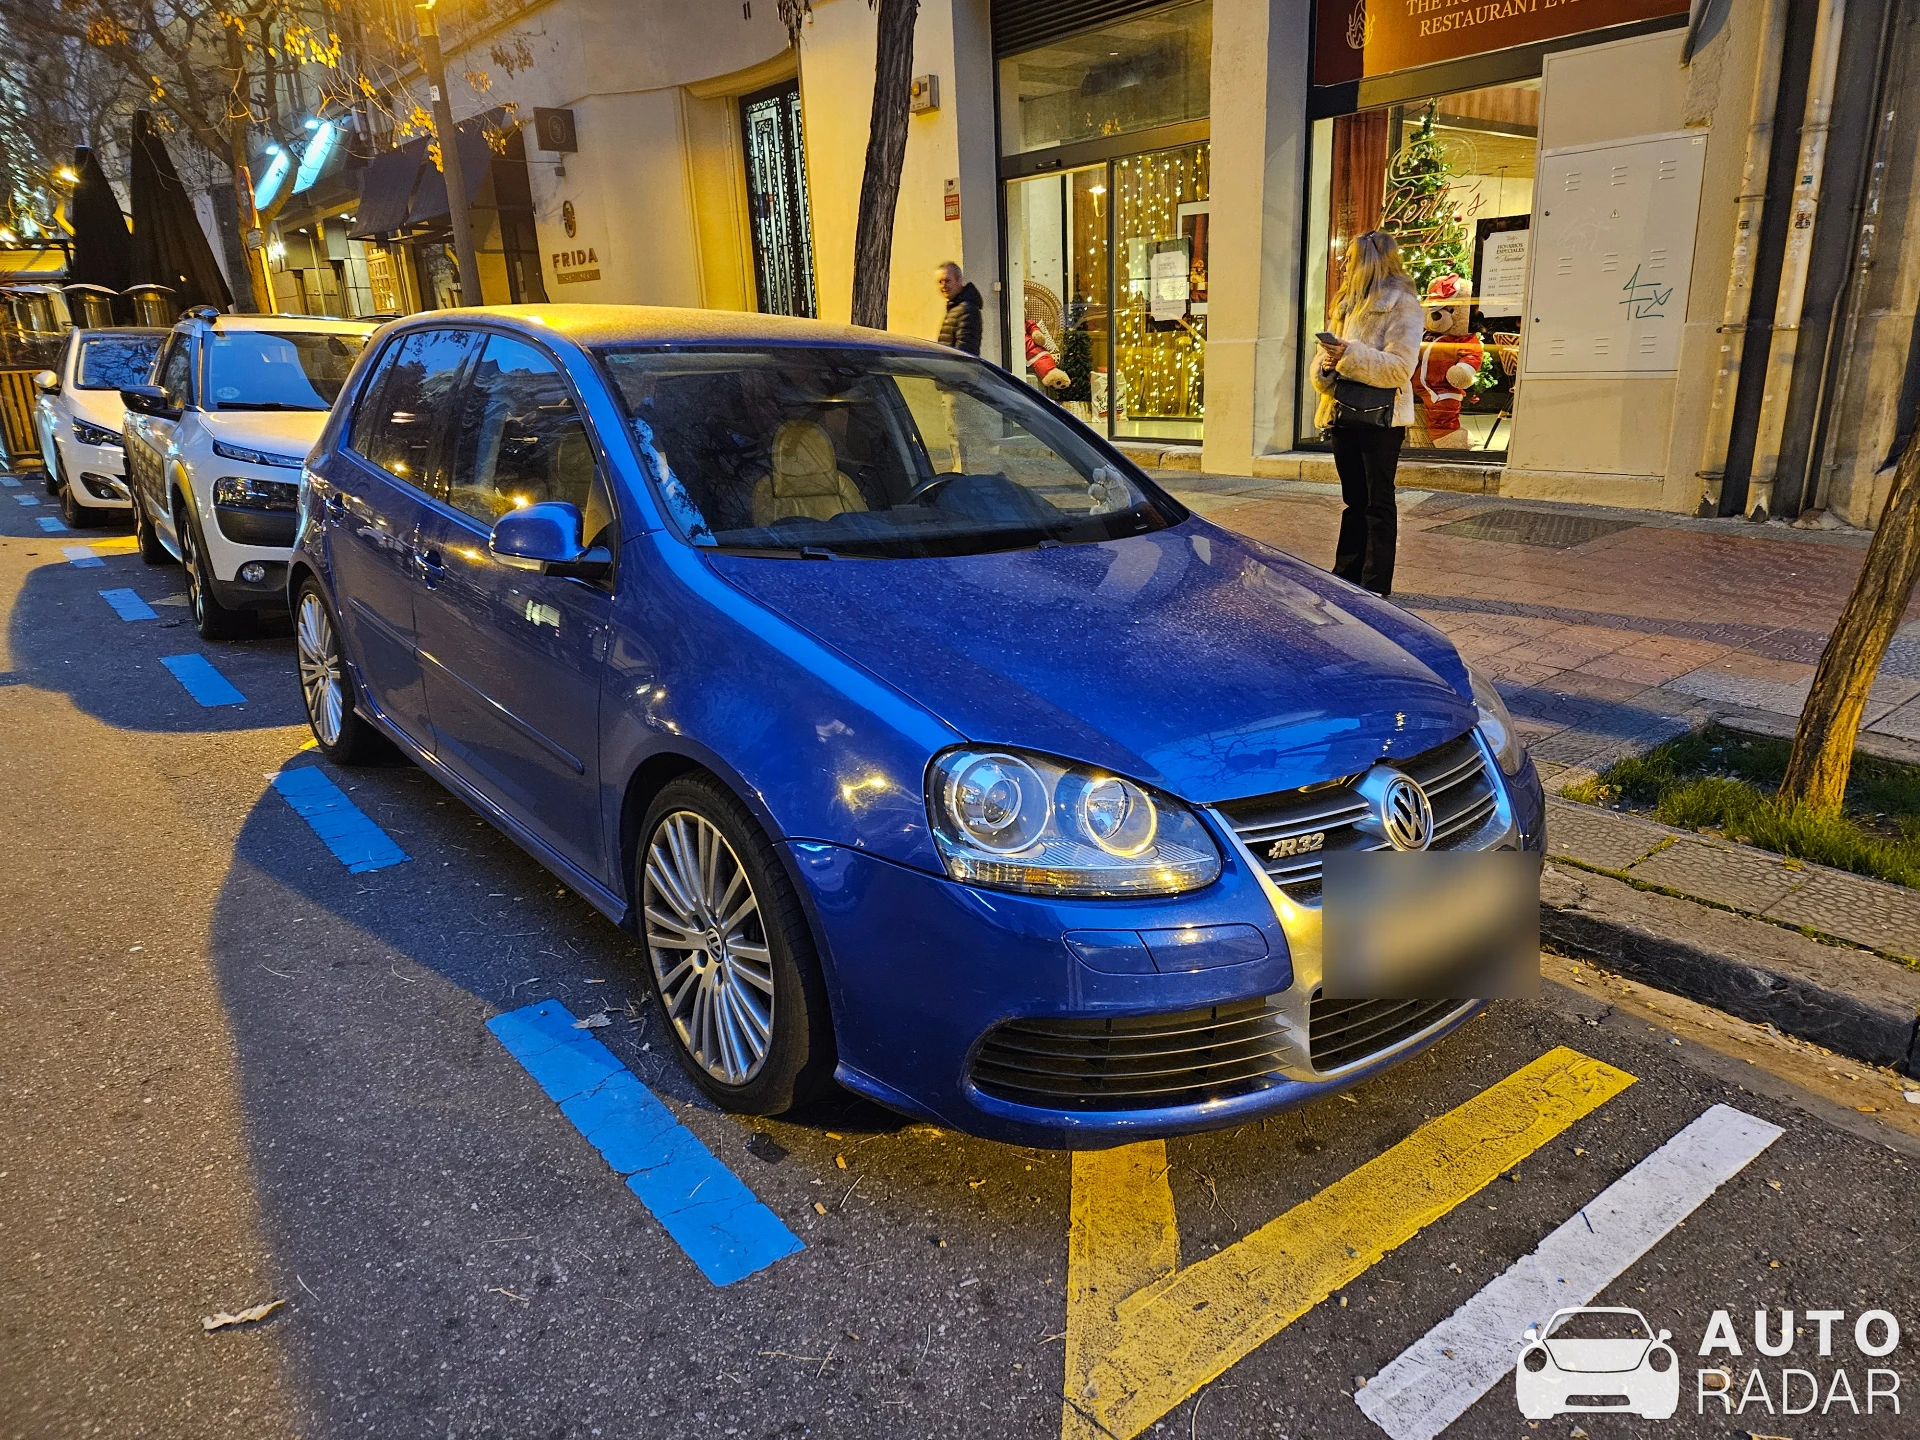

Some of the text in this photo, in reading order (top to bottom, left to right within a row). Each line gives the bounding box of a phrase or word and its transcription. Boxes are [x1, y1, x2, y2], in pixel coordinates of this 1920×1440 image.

[1406, 0, 1442, 16] THE
[1419, 0, 1538, 37] RESTAURANT
[551, 248, 598, 268] FRIDA
[1279, 832, 1325, 857] R32
